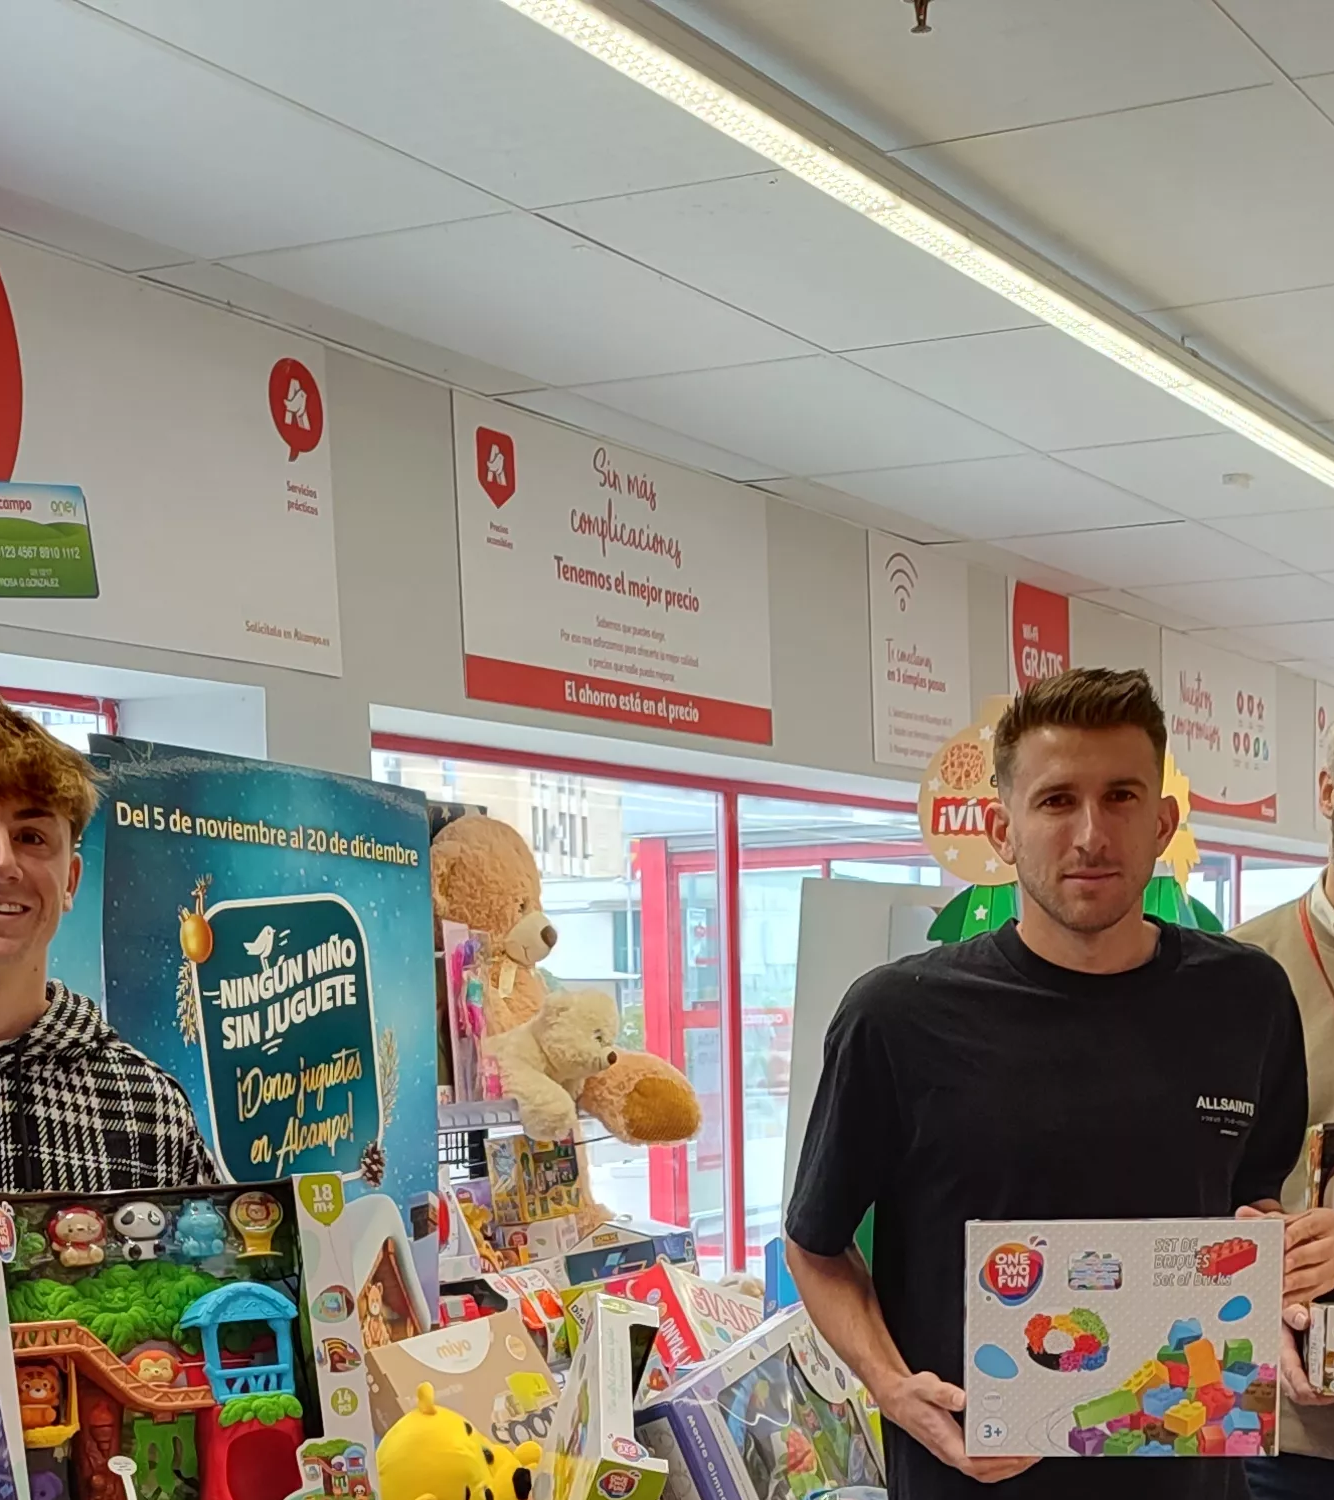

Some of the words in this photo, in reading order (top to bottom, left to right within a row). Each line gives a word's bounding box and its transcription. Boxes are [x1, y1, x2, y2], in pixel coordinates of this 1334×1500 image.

[593, 447, 623, 495] Sin
[627, 473, 658, 512] más
[570, 497, 682, 570] complicaciones
[554, 554, 612, 592] Tenemos
[614, 570, 627, 596] el
[628, 576, 663, 607] mejor
[665, 587, 700, 613] precio
[1022, 646, 1064, 681] GRATIS
[565, 680, 577, 703] El
[578, 683, 618, 709] ahorro
[619, 692, 642, 713] está
[643, 698, 656, 716] en
[657, 696, 668, 718] el
[668, 701, 700, 724] precio
[115, 801, 150, 830] Del
[153, 806, 165, 832] 5
[168, 807, 193, 837] de
[195, 812, 288, 847] noviembre
[289, 822, 304, 851] al
[306, 828, 327, 853] 20
[329, 828, 349, 857] de
[350, 832, 419, 868] diciembre
[220, 951, 303, 1010] NINGÚN
[307, 932, 357, 981] NIÑO
[221, 1015, 261, 1051] SIN
[264, 974, 357, 1043] JUGUETE
[236, 1054, 298, 1122] ¡Dona
[298, 1045, 363, 1112] juguetes
[1195, 1095, 1255, 1117] ALLSAINTS
[251, 1134, 272, 1166] en
[275, 1091, 355, 1179] Alcampo!
[310, 1183, 334, 1202] 18
[313, 1201, 335, 1213] m+
[1154, 1238, 1181, 1253] SET
[1183, 1238, 1198, 1253] DE
[995, 1253, 1030, 1265] ONE
[1154, 1254, 1211, 1270] BRIQUES
[995, 1265, 1030, 1276] TWO
[1153, 1273, 1175, 1286] Set
[1177, 1272, 1191, 1286] of
[1193, 1272, 1232, 1286] Bricks
[998, 1276, 1030, 1288] FUN
[436, 1339, 472, 1360] miyo
[337, 1387, 352, 1404] 14
[983, 1425, 1003, 1438] 3+
